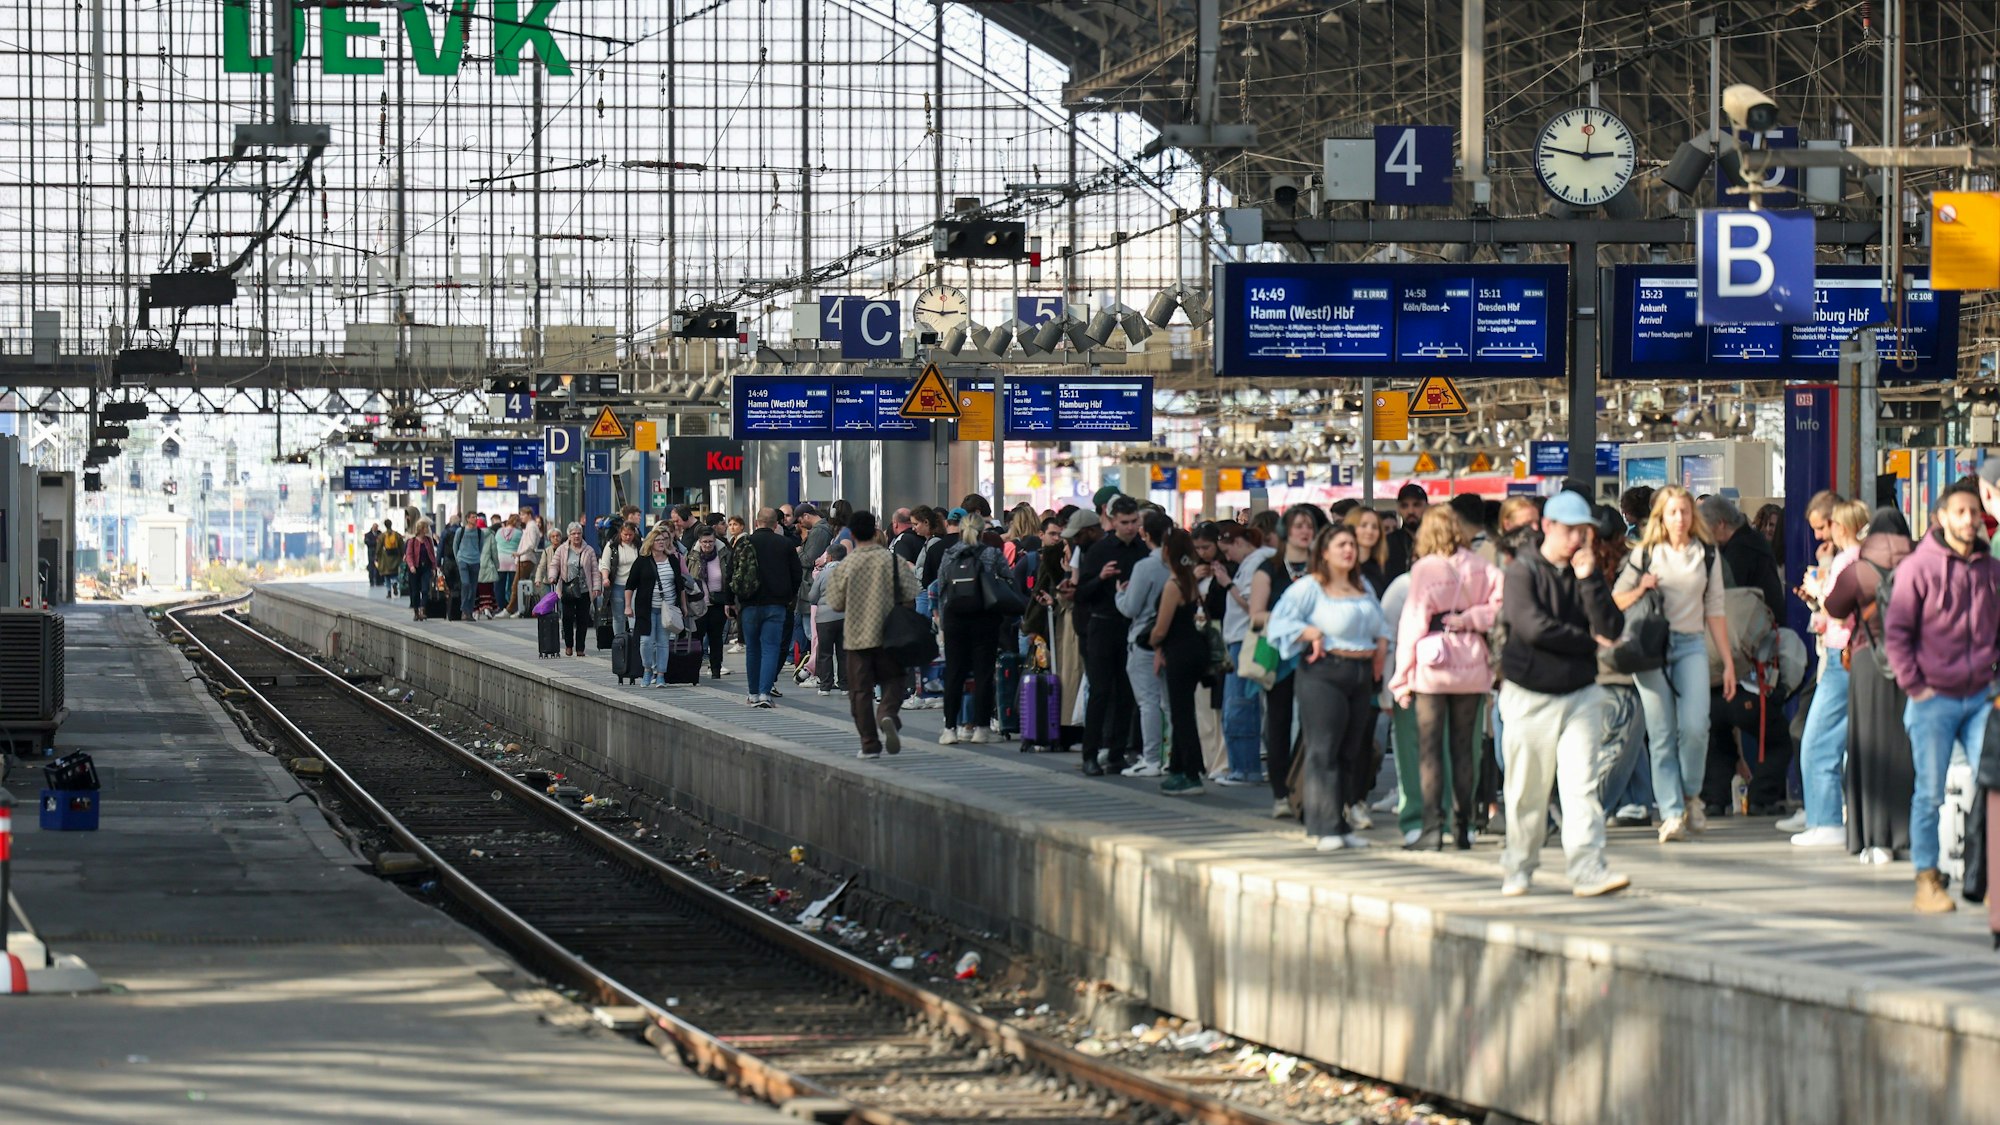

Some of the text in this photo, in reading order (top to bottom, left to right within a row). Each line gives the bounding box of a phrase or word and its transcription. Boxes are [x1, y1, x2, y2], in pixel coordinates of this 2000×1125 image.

[223, 0, 574, 76] DEVK
[1385, 128, 1422, 186] 4
[1717, 213, 1775, 298] B
[453, 252, 576, 301] HBF
[1250, 287, 1286, 301] 14:49
[1405, 289, 1427, 298] 14:58
[1479, 289, 1502, 298] 15:11
[1641, 289, 1663, 299] 15:23
[1908, 292, 1932, 301] ICE 108
[1250, 304, 1355, 321] Hamm (Westf) Hbf
[1403, 302, 1440, 312] Köln/Bonn
[1478, 302, 1520, 311] Dresden Hbf
[1639, 303, 1668, 312] Ankunft
[826, 297, 843, 331] 4
[1035, 298, 1056, 331] 5
[1638, 315, 1663, 324] Arrival
[1848, 308, 1869, 322] Hbf
[860, 302, 892, 347] C
[748, 389, 768, 398] 14:49
[1060, 390, 1079, 398] 15:11
[1797, 394, 1812, 405] DB
[508, 393, 522, 414] 4
[748, 399, 809, 409] Hamm (Westf) Hbf
[1059, 400, 1089, 410] Hamburg
[1090, 399, 1103, 408] Hbf
[1796, 416, 1820, 431] Info
[550, 428, 570, 456] D
[421, 457, 435, 477] E
[1338, 465, 1351, 483] E
[391, 470, 401, 487] F
[1287, 472, 1298, 485] F
